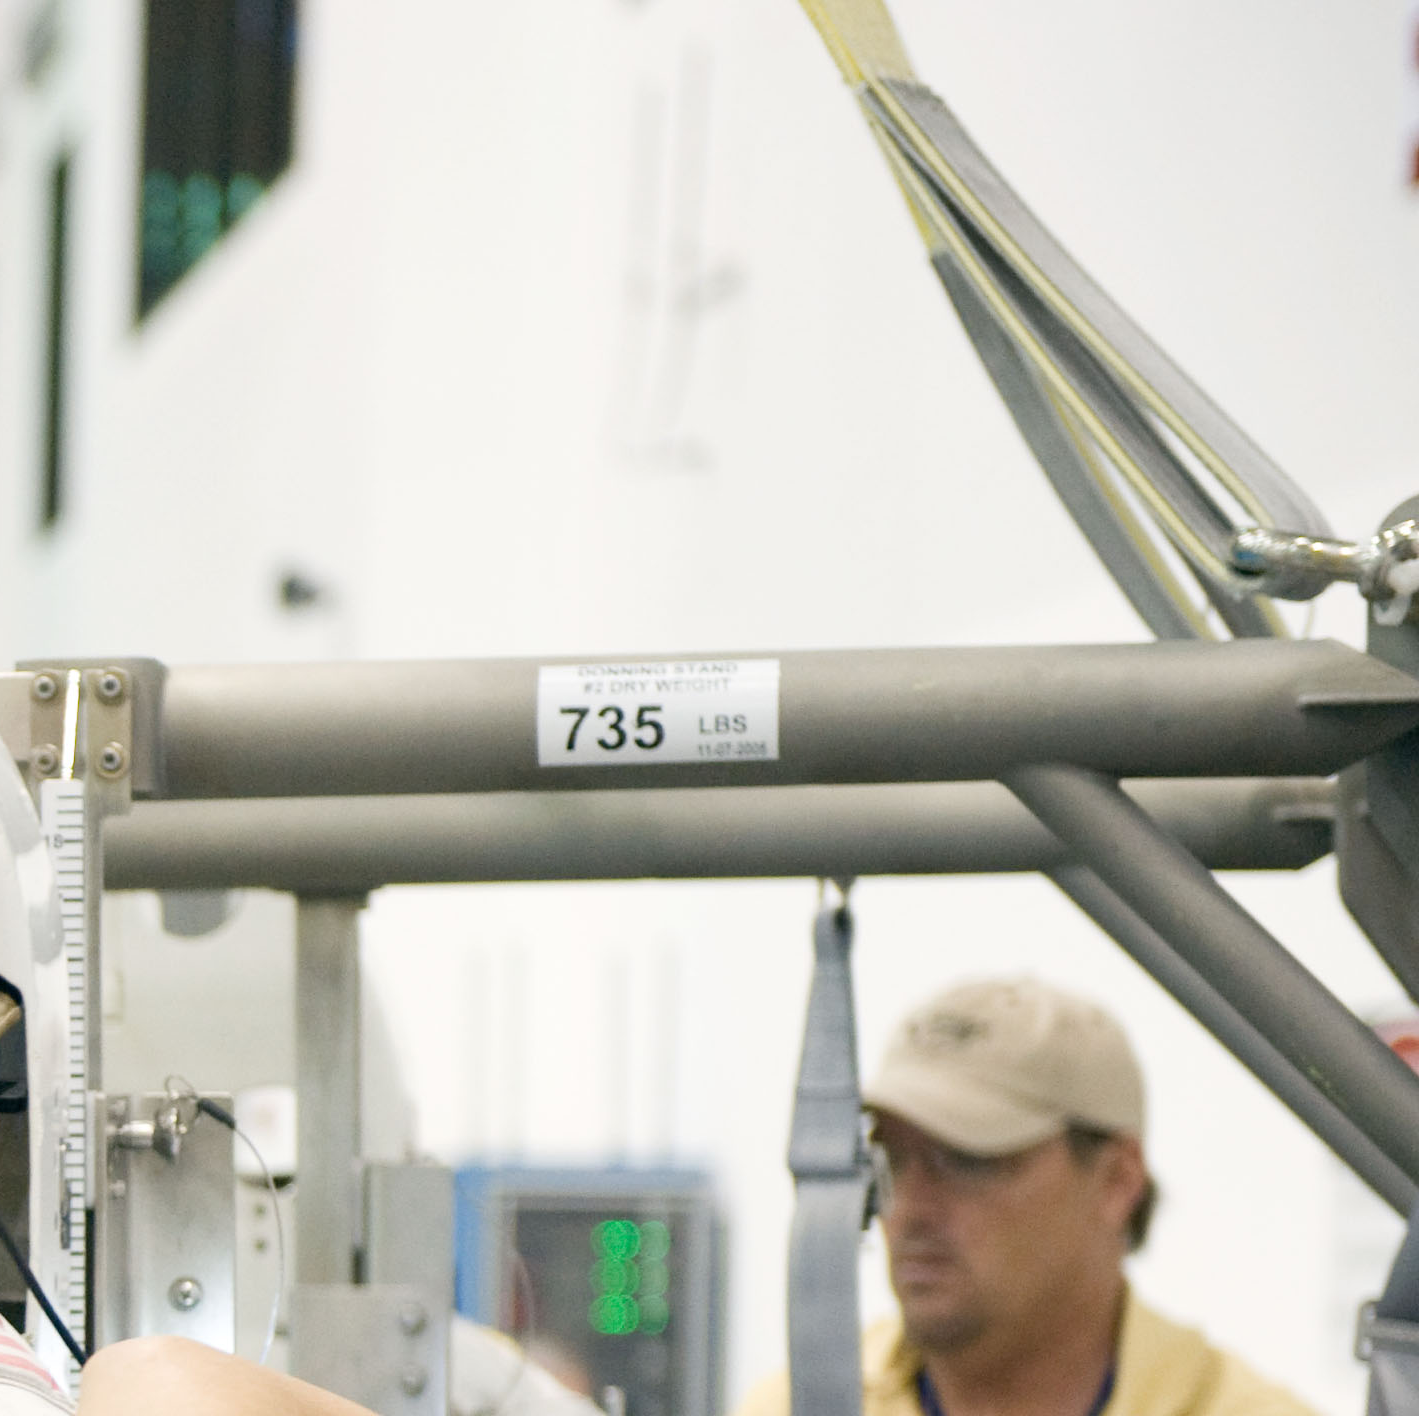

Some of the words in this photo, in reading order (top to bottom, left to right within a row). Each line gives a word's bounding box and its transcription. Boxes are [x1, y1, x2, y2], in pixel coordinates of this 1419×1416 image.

[577, 663, 667, 677] DONNING
[674, 660, 738, 675] STAND
[611, 680, 646, 694] DRY
[655, 677, 730, 693] WEIGHT
[560, 704, 666, 751] 735
[699, 714, 747, 735] LBS
